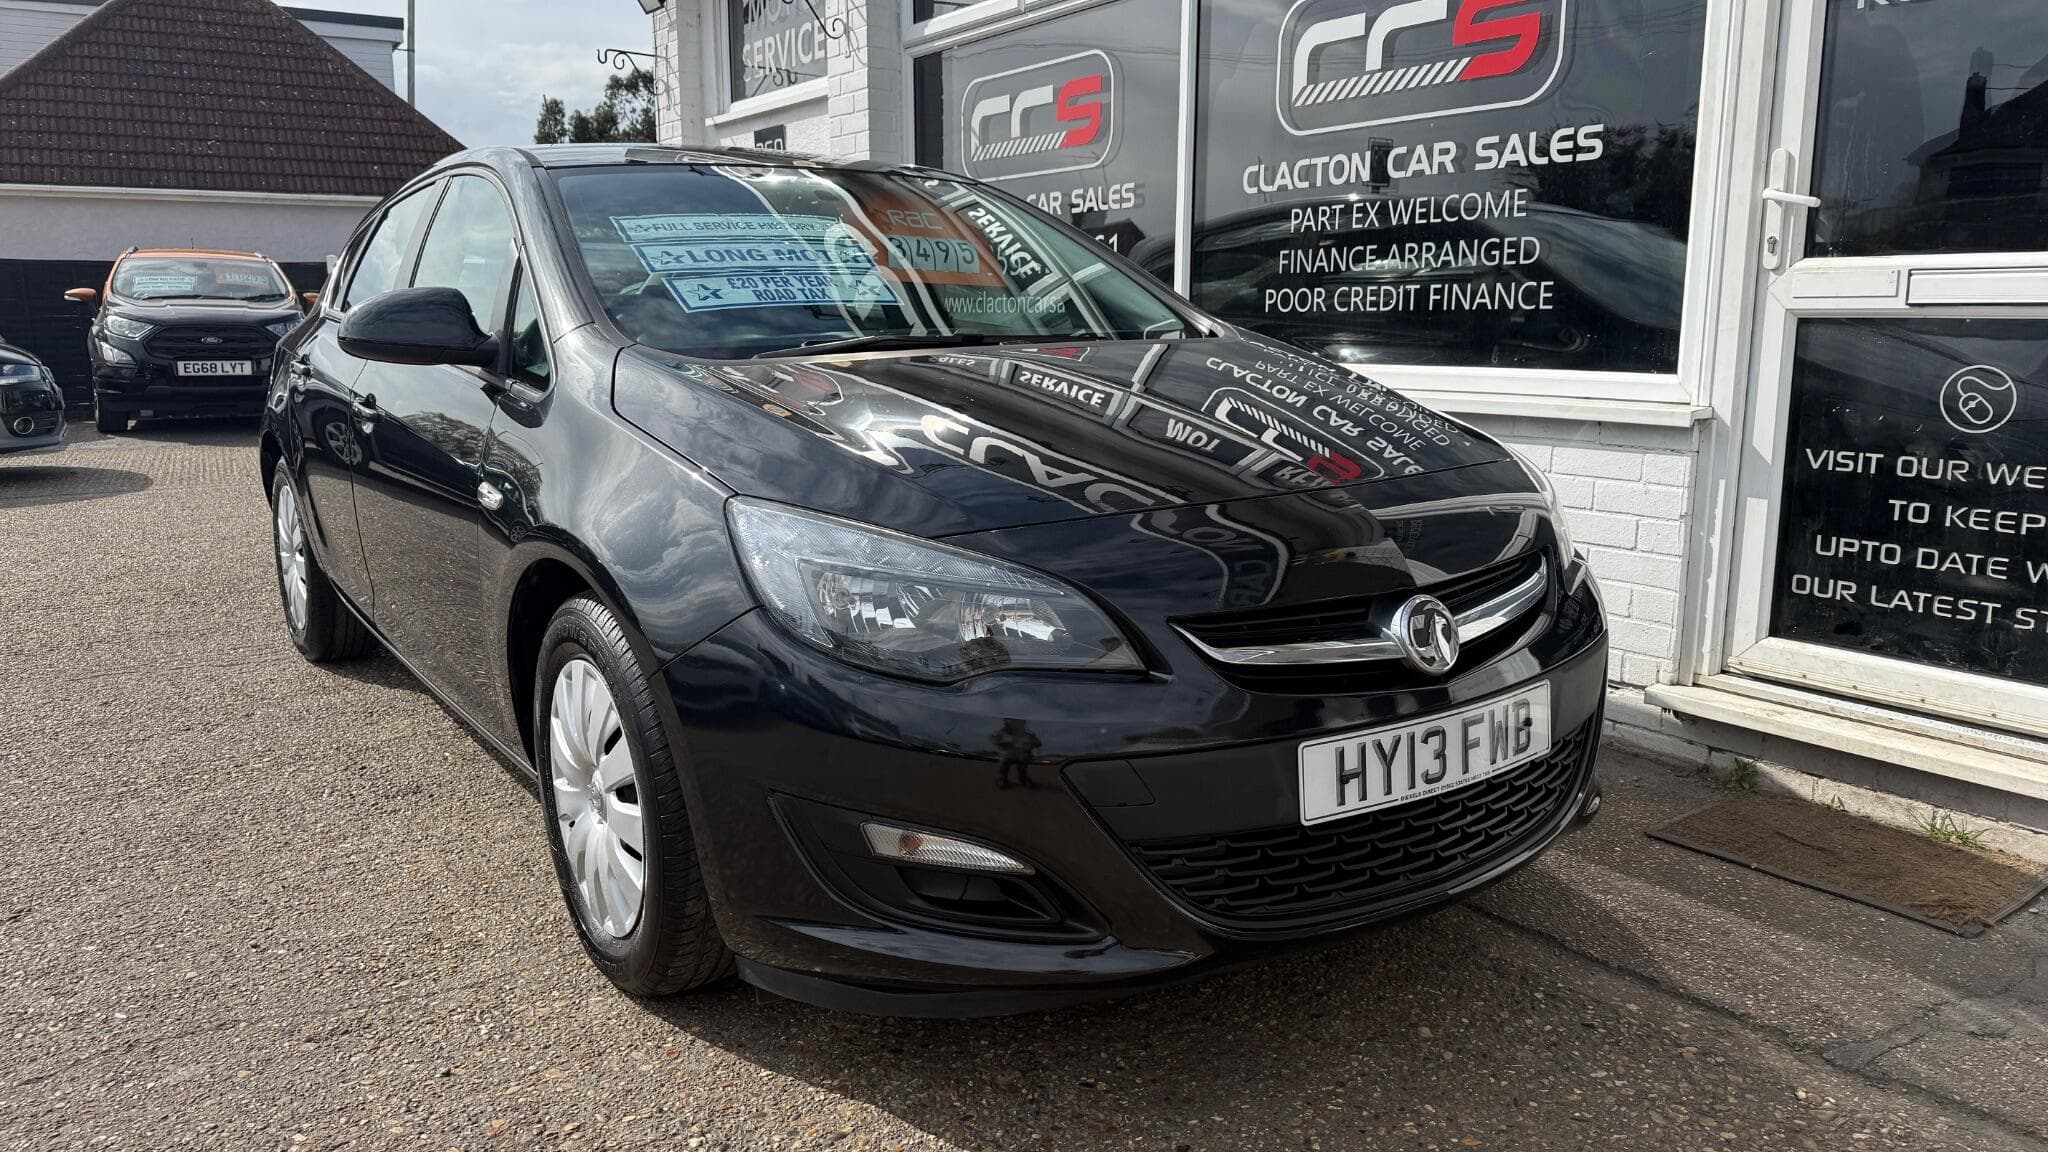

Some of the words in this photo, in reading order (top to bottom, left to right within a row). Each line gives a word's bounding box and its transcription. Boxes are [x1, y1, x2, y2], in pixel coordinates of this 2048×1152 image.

[743, 20, 825, 82] SERVICE
[1243, 150, 1371, 194] CLACTON
[1387, 141, 1457, 178] CAR
[1475, 124, 1604, 171] SALES
[1071, 182, 1135, 214] SALES
[1290, 204, 1344, 234] PART
[1351, 201, 1380, 229] EX
[1389, 188, 1528, 226] WELCOME
[651, 223, 692, 232] FULL
[693, 221, 757, 231] SERVICE
[685, 249, 768, 262] LONG
[772, 249, 832, 262] MOT
[1279, 245, 1377, 274] FINANCE
[1387, 236, 1540, 270] ARRANGED
[727, 277, 758, 289] £20
[760, 276, 794, 288] PER
[793, 275, 832, 288] YEAR
[752, 289, 797, 301] ROAD
[797, 288, 832, 300] TAX
[1265, 287, 1327, 313] POOR
[1334, 284, 1420, 312] CREDIT
[1429, 280, 1554, 311] FINANCE
[183, 362, 217, 374] EG68
[221, 362, 245, 374] LYT
[1805, 448, 1884, 474] VISIT
[1896, 455, 1969, 483] OUR
[1986, 462, 2048, 489] WE
[1888, 499, 1930, 524] TO
[1945, 505, 2046, 535] KEEP
[1815, 534, 1901, 565] UPTO
[1916, 547, 2010, 580] DATE
[1791, 574, 1857, 603] OUR
[1870, 585, 2002, 624] LATEST
[1334, 725, 1448, 806] HY13
[1461, 698, 1533, 775] FWB
